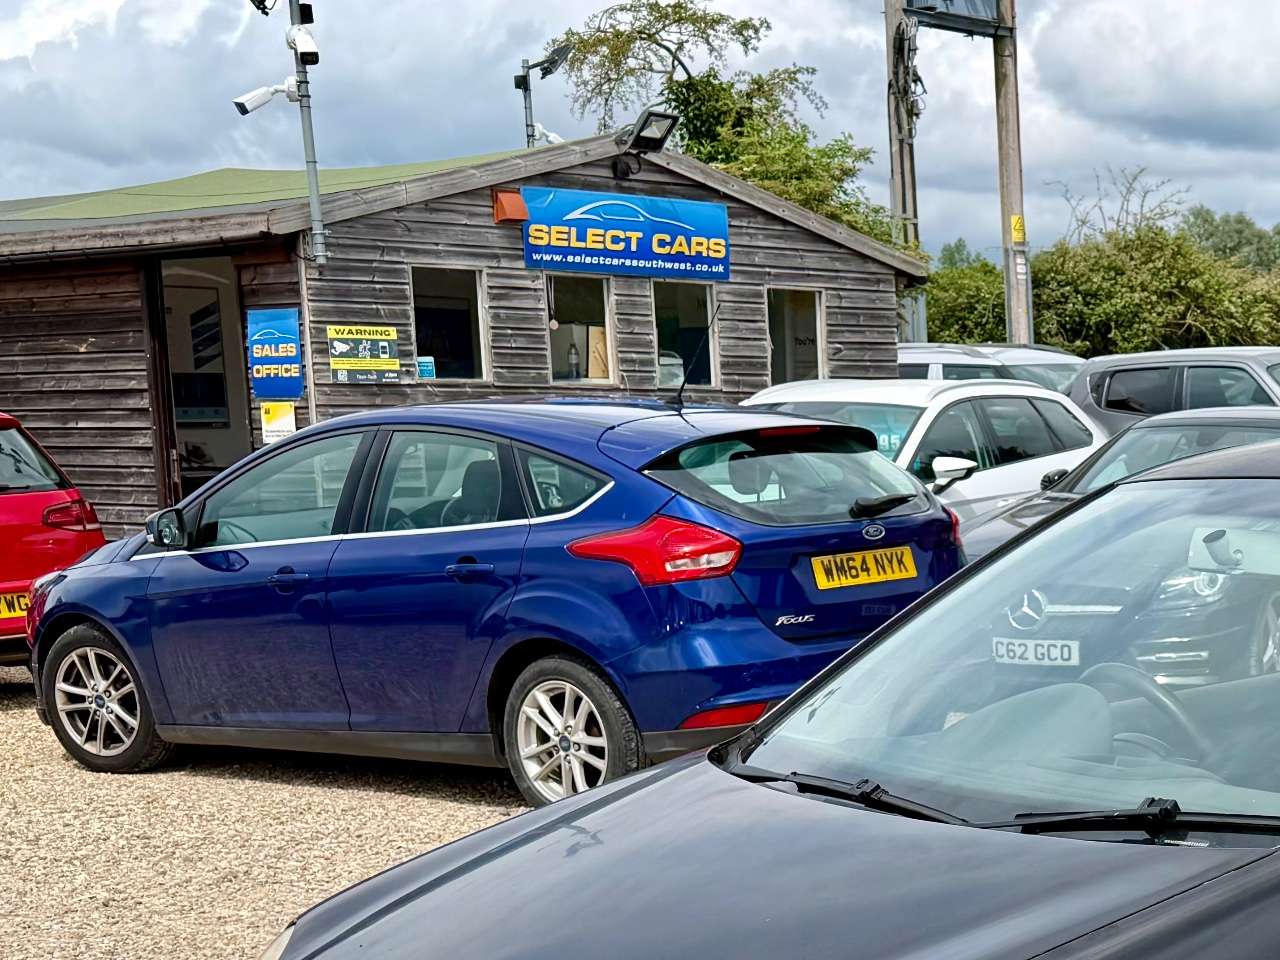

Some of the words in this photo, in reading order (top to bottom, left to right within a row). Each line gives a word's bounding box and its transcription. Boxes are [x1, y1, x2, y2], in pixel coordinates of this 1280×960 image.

[528, 224, 643, 251] SELECT
[652, 233, 726, 258] CARS
[532, 251, 725, 273] www.selectcarssouthwest.co.uk
[333, 328, 391, 336] WARNING
[253, 343, 296, 357] SALES
[253, 364, 300, 377] OFFICE
[820, 555, 871, 583] WM64
[872, 550, 909, 576] NYK
[0, 594, 29, 614] WG
